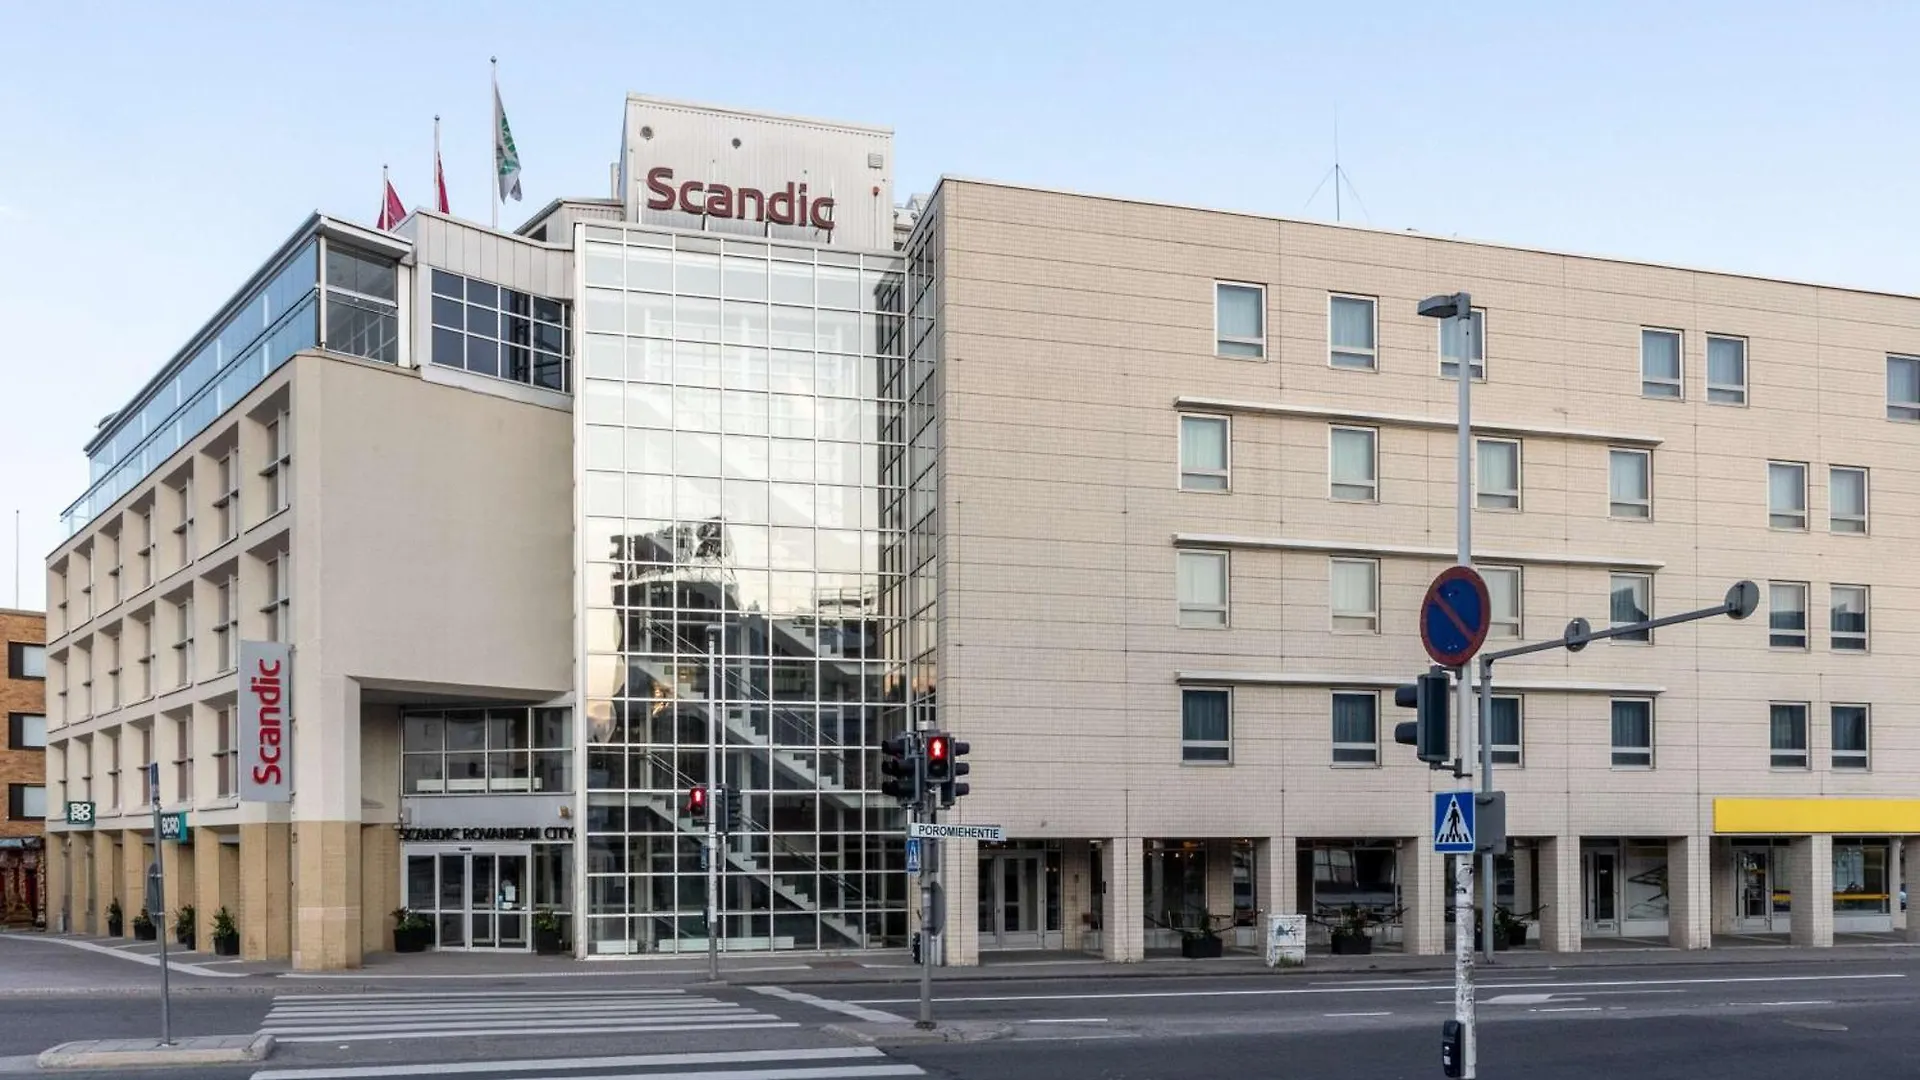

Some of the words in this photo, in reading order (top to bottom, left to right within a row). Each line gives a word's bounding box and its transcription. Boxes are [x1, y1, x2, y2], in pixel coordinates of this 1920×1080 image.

[646, 166, 835, 230] Scandic
[251, 658, 281, 786] Scandic
[400, 827, 460, 841] SCANDIC
[463, 826, 541, 841] ROVANIEMI
[544, 826, 575, 840] CITY
[918, 824, 1000, 840] POROMIEHENTIE
